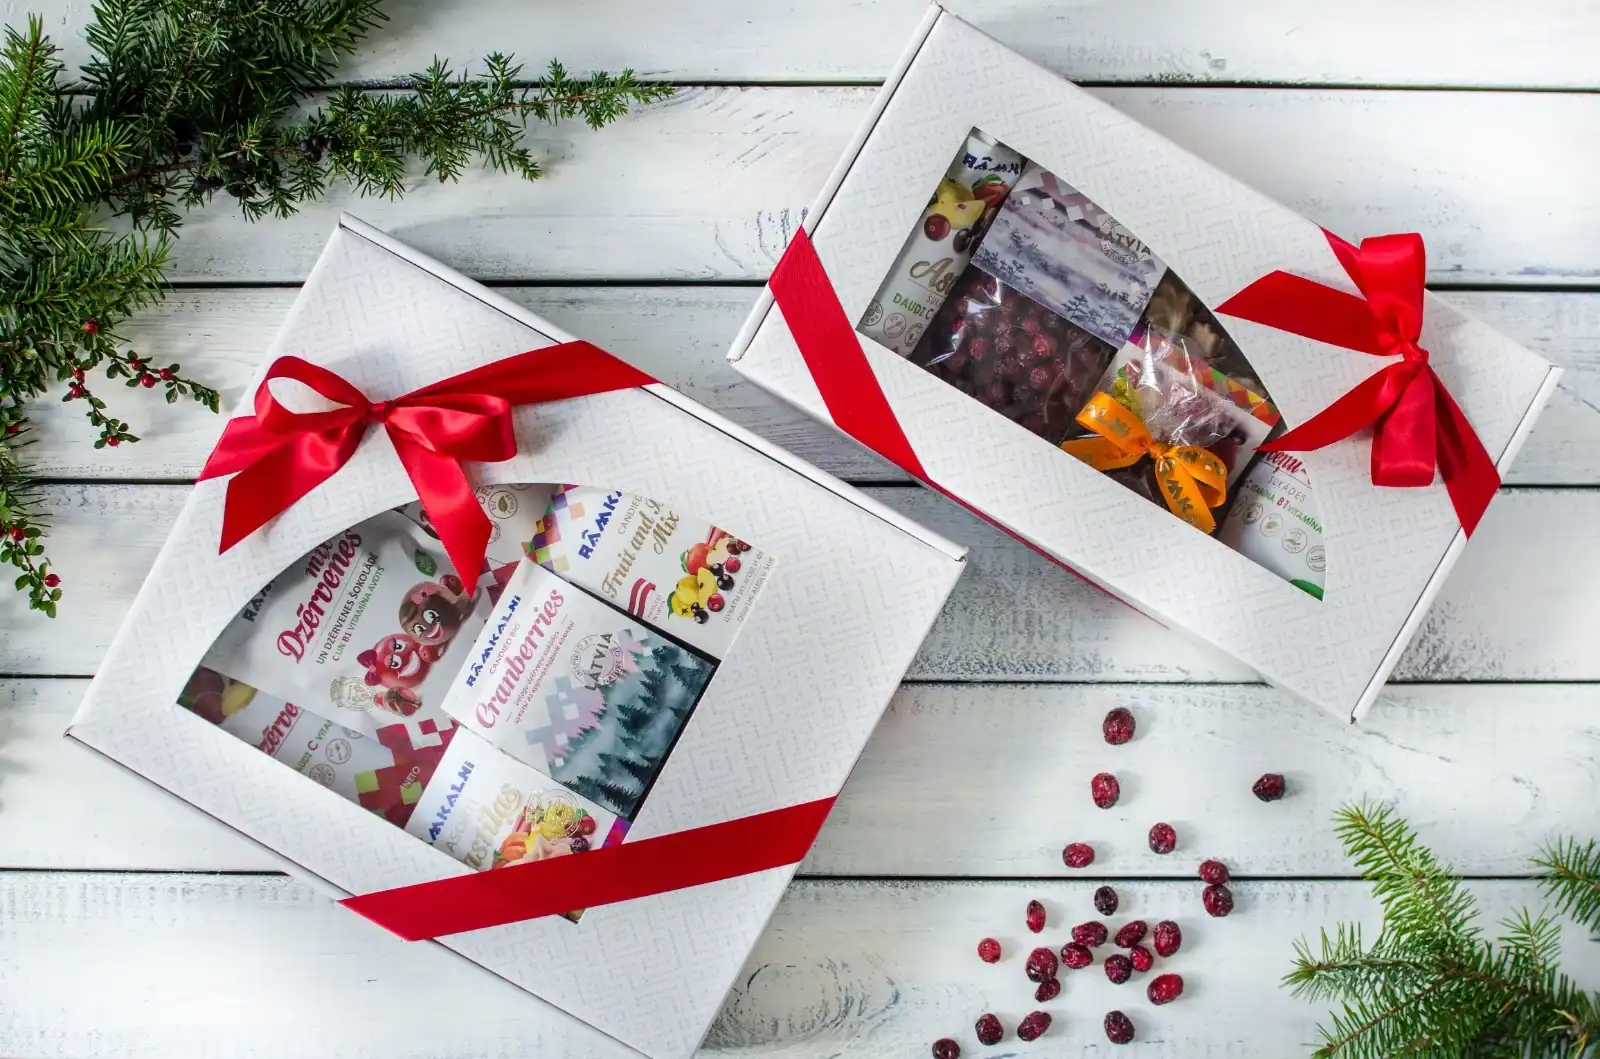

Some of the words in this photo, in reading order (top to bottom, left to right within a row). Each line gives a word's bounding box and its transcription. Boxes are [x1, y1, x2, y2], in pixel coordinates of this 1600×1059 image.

[653, 512, 679, 554] Mix
[1277, 497, 1289, 508] B1
[602, 550, 636, 598] Fruit
[631, 511, 654, 550] and
[277, 529, 363, 664] Dzērvenes
[336, 642, 346, 655] UN
[342, 632, 352, 642] B1
[368, 565, 384, 592] AVOTS
[316, 650, 328, 665] UN
[324, 600, 354, 650] DZĒRVENES
[477, 591, 563, 728] Cranberries
[585, 634, 612, 691] LATVIA
[308, 740, 318, 751] C
